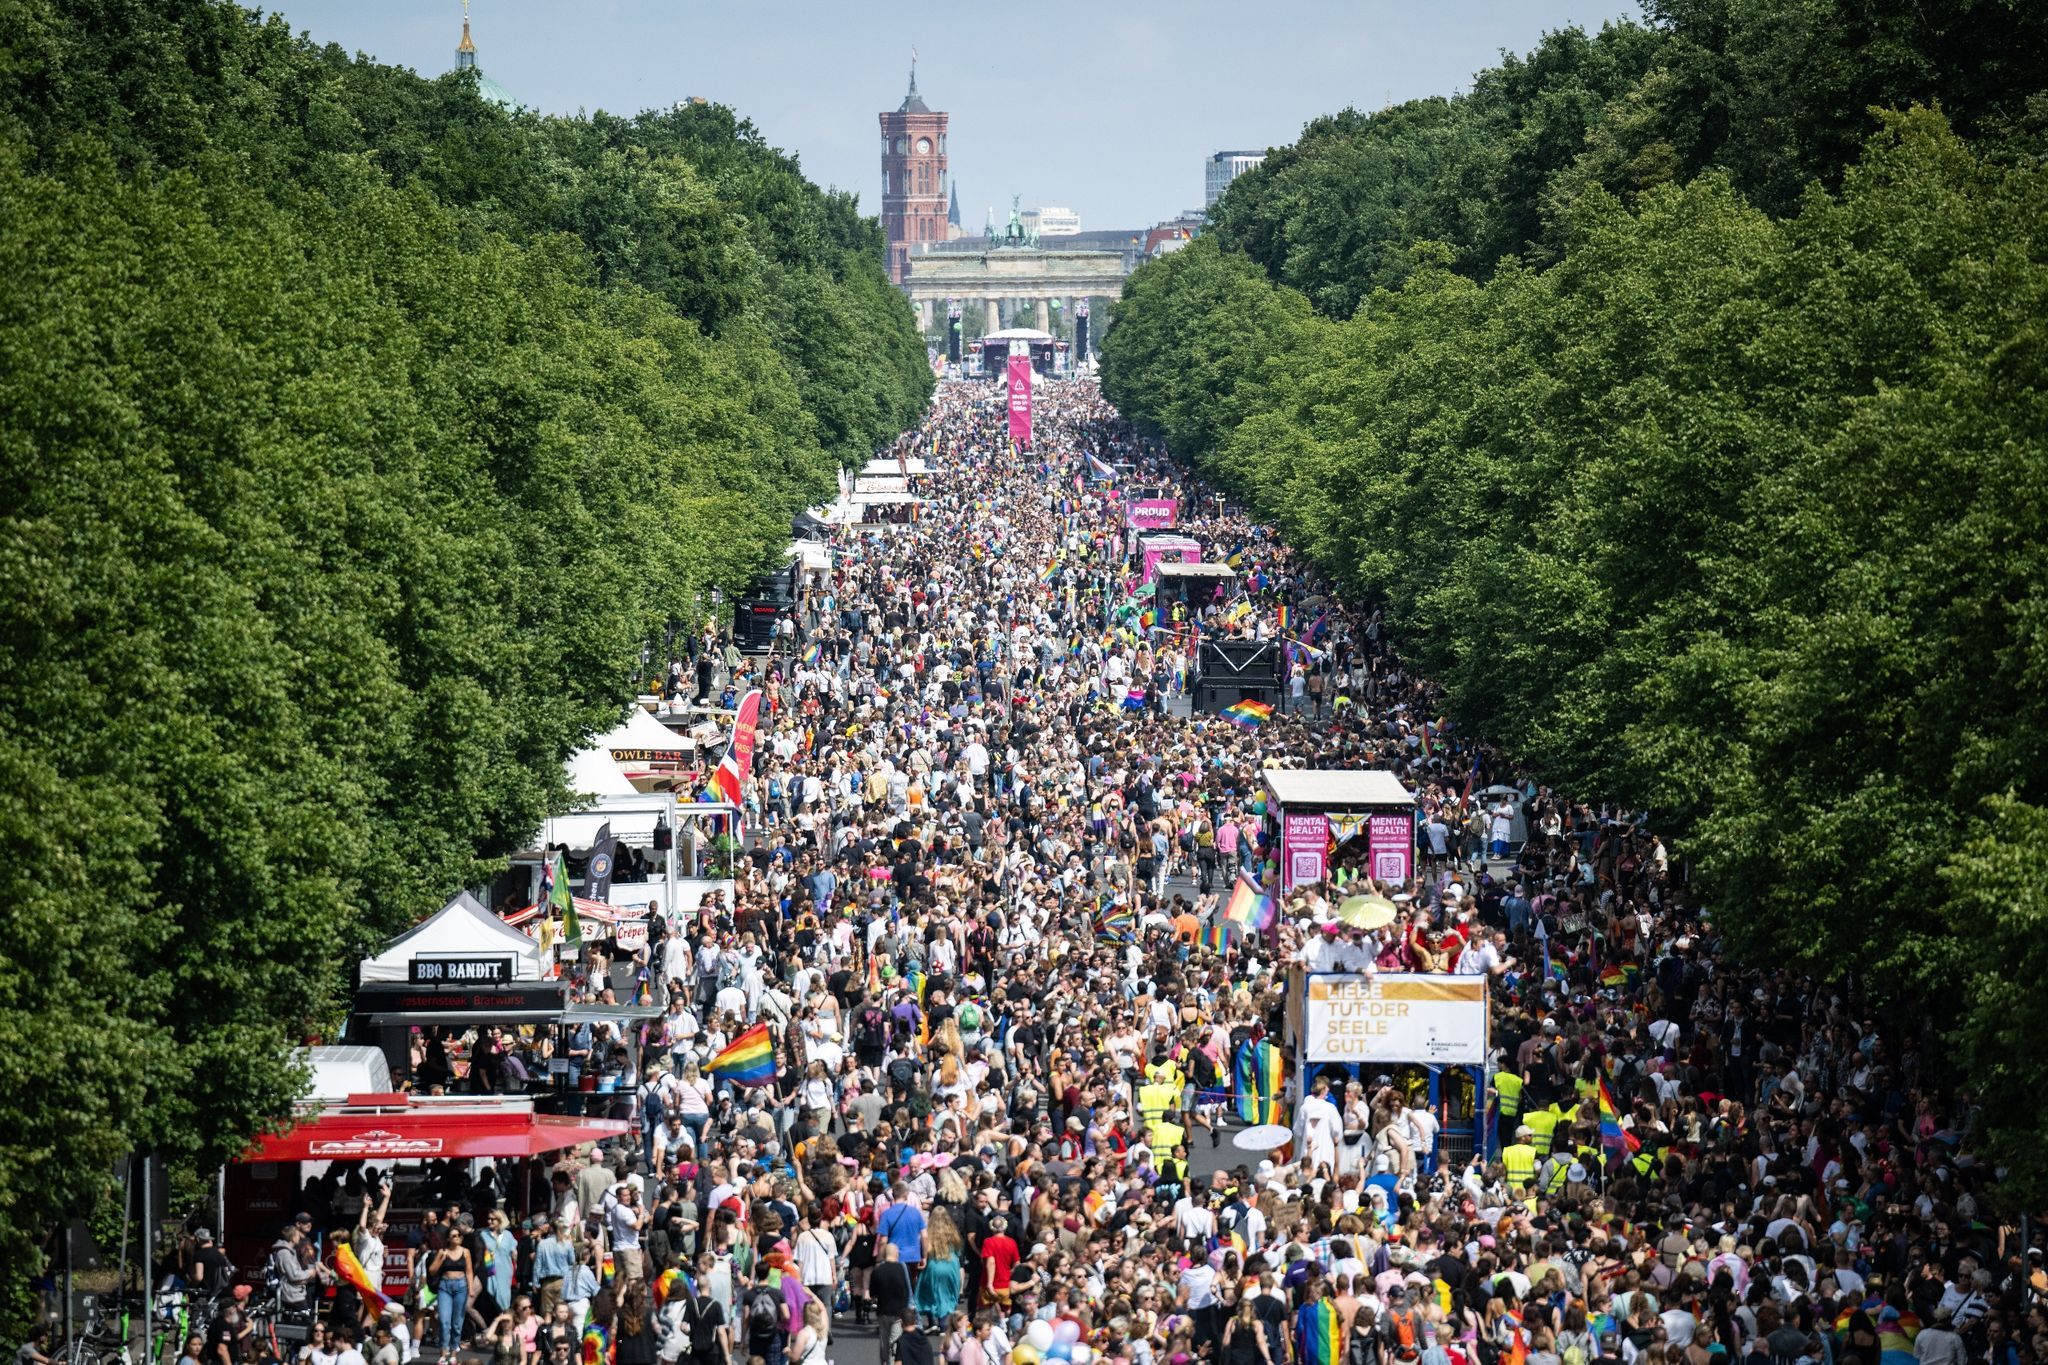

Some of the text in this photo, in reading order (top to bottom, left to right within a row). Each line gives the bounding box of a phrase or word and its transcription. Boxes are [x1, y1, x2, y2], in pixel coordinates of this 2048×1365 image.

[1134, 507, 1170, 517] PROUD
[612, 750, 682, 761] OWLE BAR
[1289, 817, 1326, 825] MENTAL
[1371, 817, 1408, 826] MENTAL
[1289, 827, 1324, 835] HEALTH
[1371, 827, 1407, 835] HEALTH
[617, 925, 646, 939] Crêpes
[417, 962, 502, 979] BBQ BANDIT
[1327, 982, 1383, 999] LIEBE
[473, 994, 526, 1006] Bratwurst
[1328, 1002, 1409, 1017] TUT DER
[1327, 1020, 1388, 1035] SEELE
[1326, 1039, 1370, 1054] GUT.
[321, 1140, 431, 1148] ASTRA
